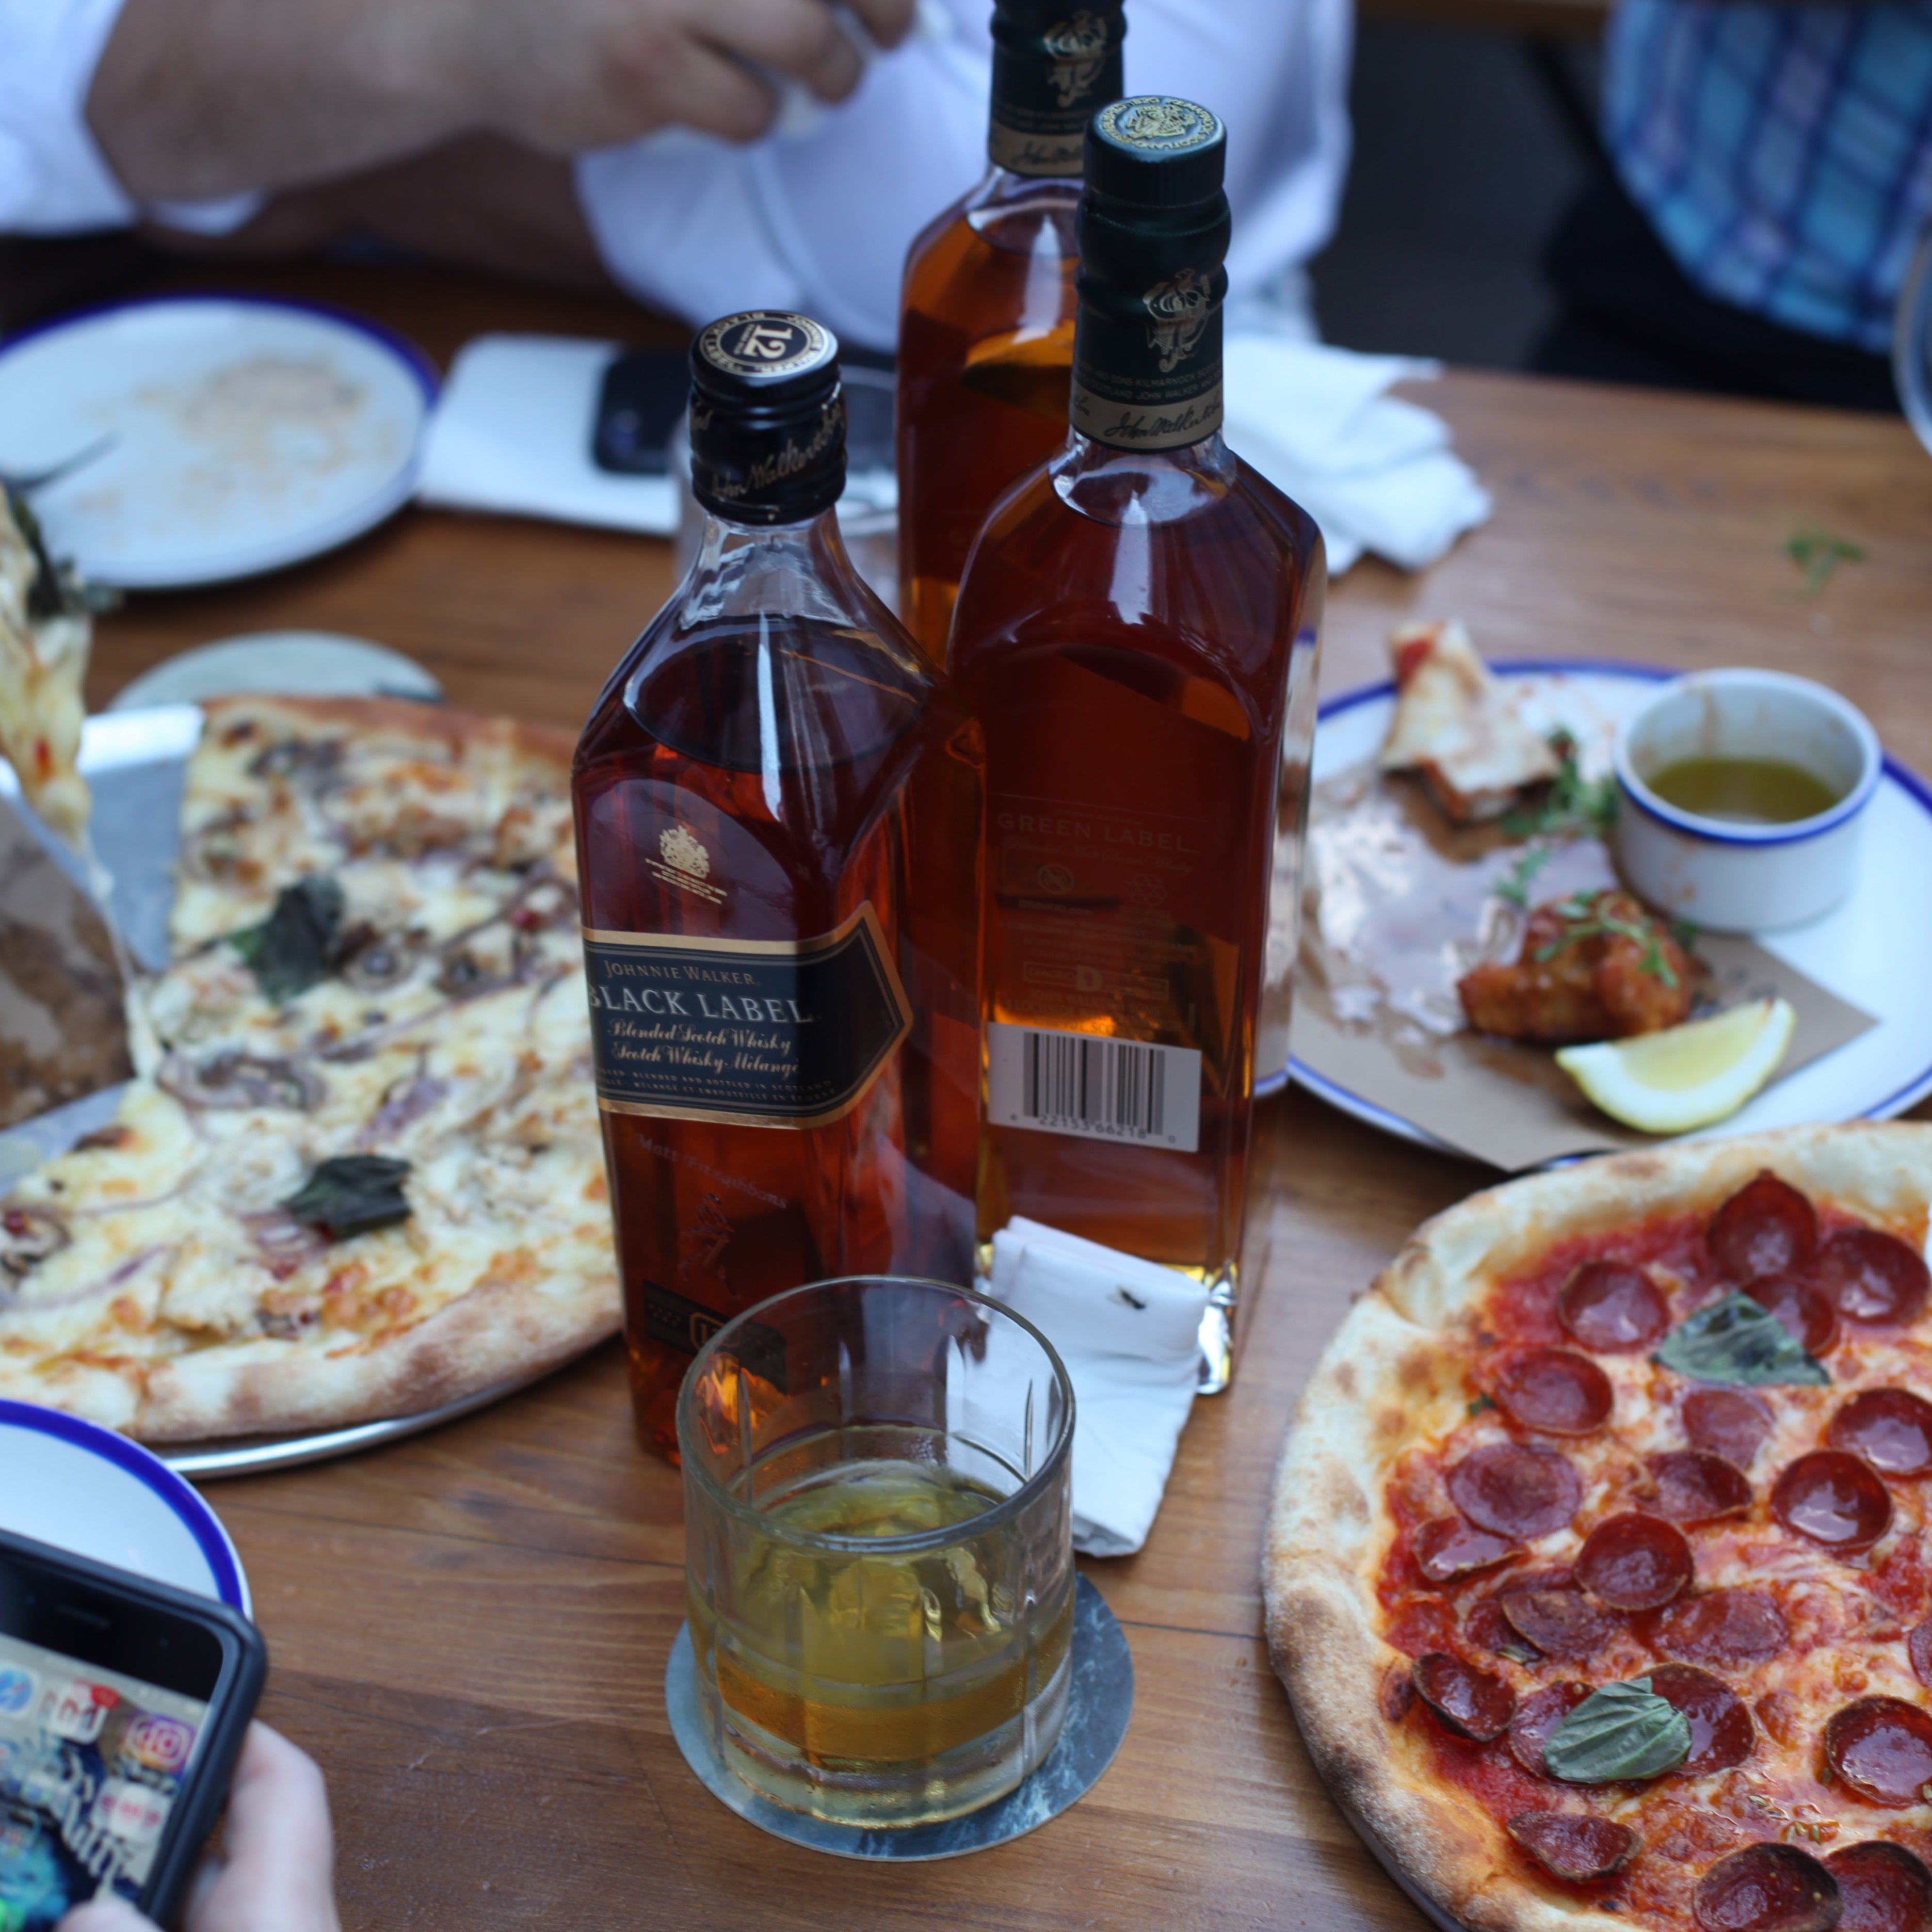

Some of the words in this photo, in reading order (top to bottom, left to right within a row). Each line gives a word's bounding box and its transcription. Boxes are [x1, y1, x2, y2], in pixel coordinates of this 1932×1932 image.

[743, 324, 793, 359] 12
[997, 812, 1091, 839] GREEN
[1104, 825, 1200, 854] LABEL
[603, 960, 682, 979] JOHNNIE
[682, 965, 755, 985] WALKER
[695, 992, 814, 1023] LABEL
[608, 1018, 677, 1040] Blended
[676, 1023, 727, 1045] Scotch
[727, 1028, 792, 1057] Whisky
[611, 1041, 662, 1062] Scotch
[661, 1045, 723, 1075] Whisky
